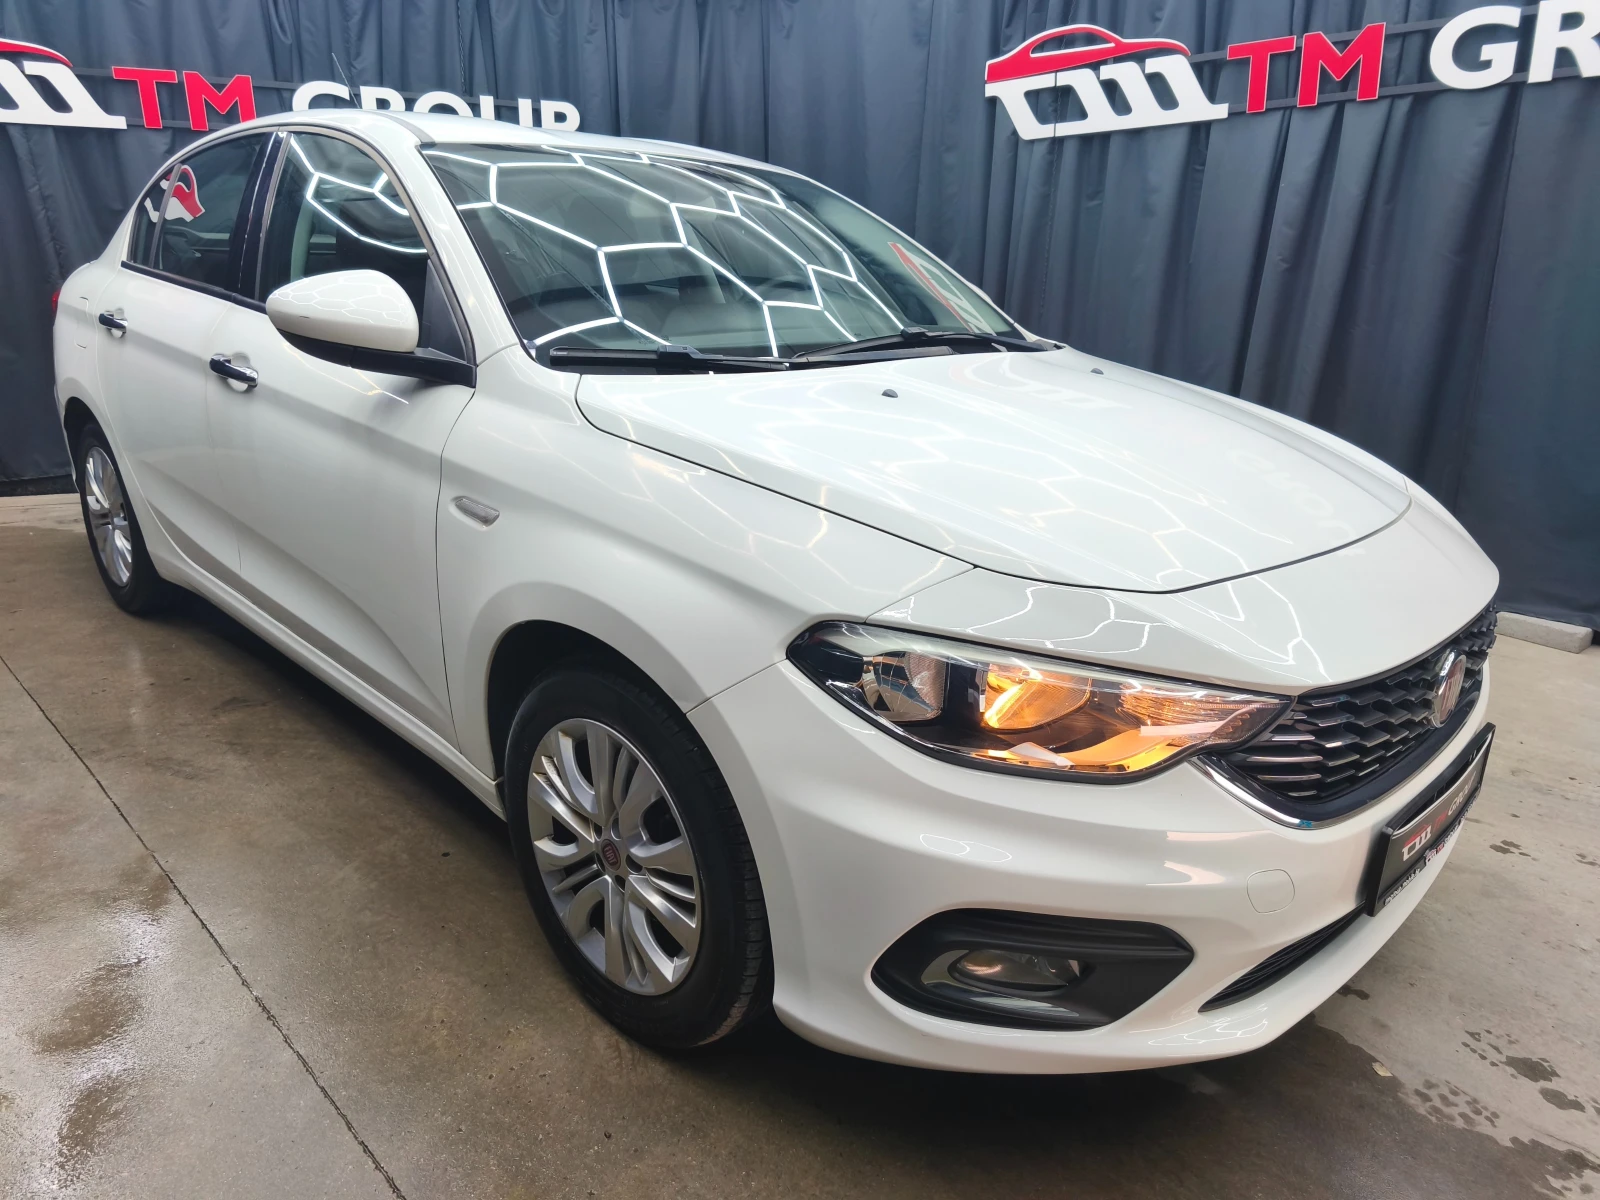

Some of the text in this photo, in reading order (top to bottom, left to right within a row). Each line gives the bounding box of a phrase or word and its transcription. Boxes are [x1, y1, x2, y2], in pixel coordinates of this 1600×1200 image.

[1227, 0, 1600, 114] TM GR
[111, 66, 257, 131] TM
[604, 845, 618, 864] FIAT
